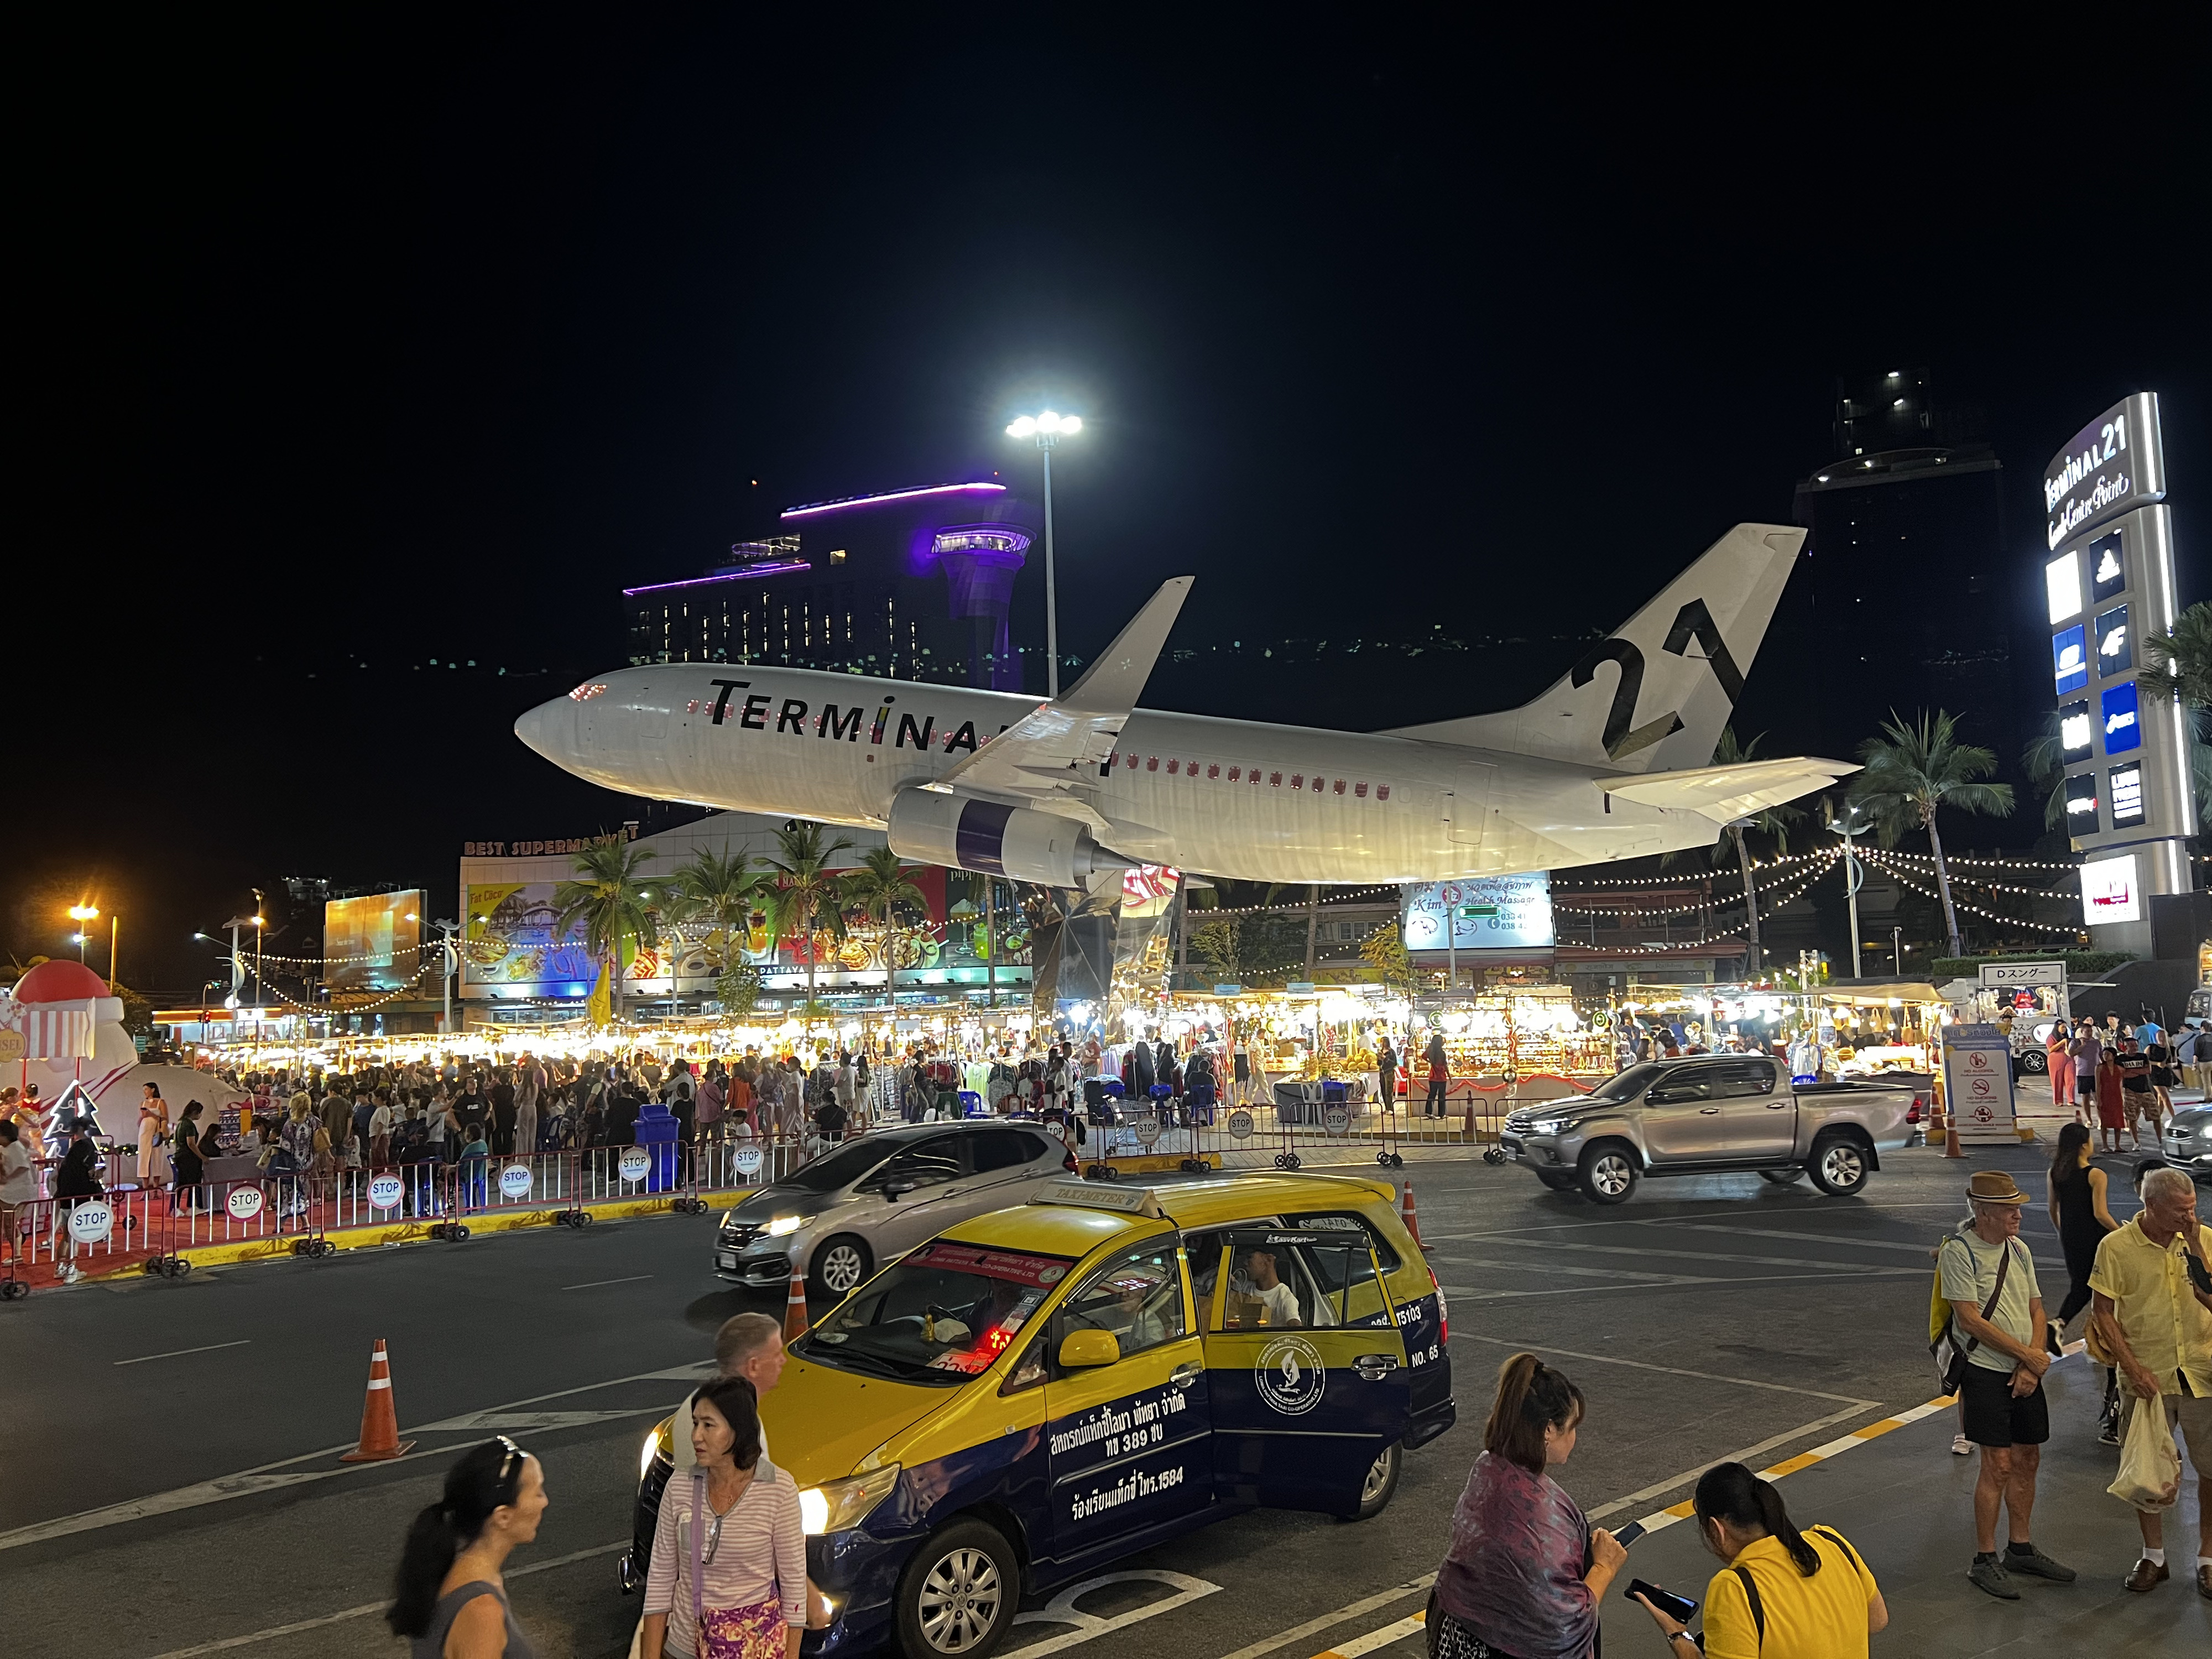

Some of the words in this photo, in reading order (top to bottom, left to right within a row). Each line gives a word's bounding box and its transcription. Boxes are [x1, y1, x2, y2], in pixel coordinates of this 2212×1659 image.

[2101, 414, 2126, 461] 21
[1571, 597, 1745, 762] 21
[710, 679, 1009, 754] TERMINA
[465, 842, 504, 855] BEST
[512, 825, 639, 855] SUPERMARKET
[470, 893, 482, 904] Fat
[484, 890, 503, 902] Coco
[1414, 899, 1443, 912] Kim
[1465, 896, 1494, 905] Health
[1497, 895, 1535, 906] Massage
[760, 966, 805, 974] PATTAYA
[0, 1039, 22, 1051] SEL
[1232, 1119, 1250, 1128] STOP
[1327, 1115, 1346, 1124] STOP
[1049, 1127, 1063, 1136] TOP
[1139, 1123, 1157, 1133] STOP
[624, 1156, 646, 1167] STOP
[738, 1151, 759, 1161] STOP
[504, 1171, 528, 1181] STOP
[373, 1182, 399, 1193] STOP
[231, 1193, 259, 1206] STOP
[1055, 1188, 1126, 1204] TAXI-METER
[76, 1212, 107, 1226] STOP
[1412, 1351, 1426, 1368] NO.
[1429, 1344, 1438, 1360] 65
[1133, 1400, 1160, 1426] พัทยา
[1162, 1388, 1186, 1416] จำกัด
[1123, 1430, 1147, 1453] 389
